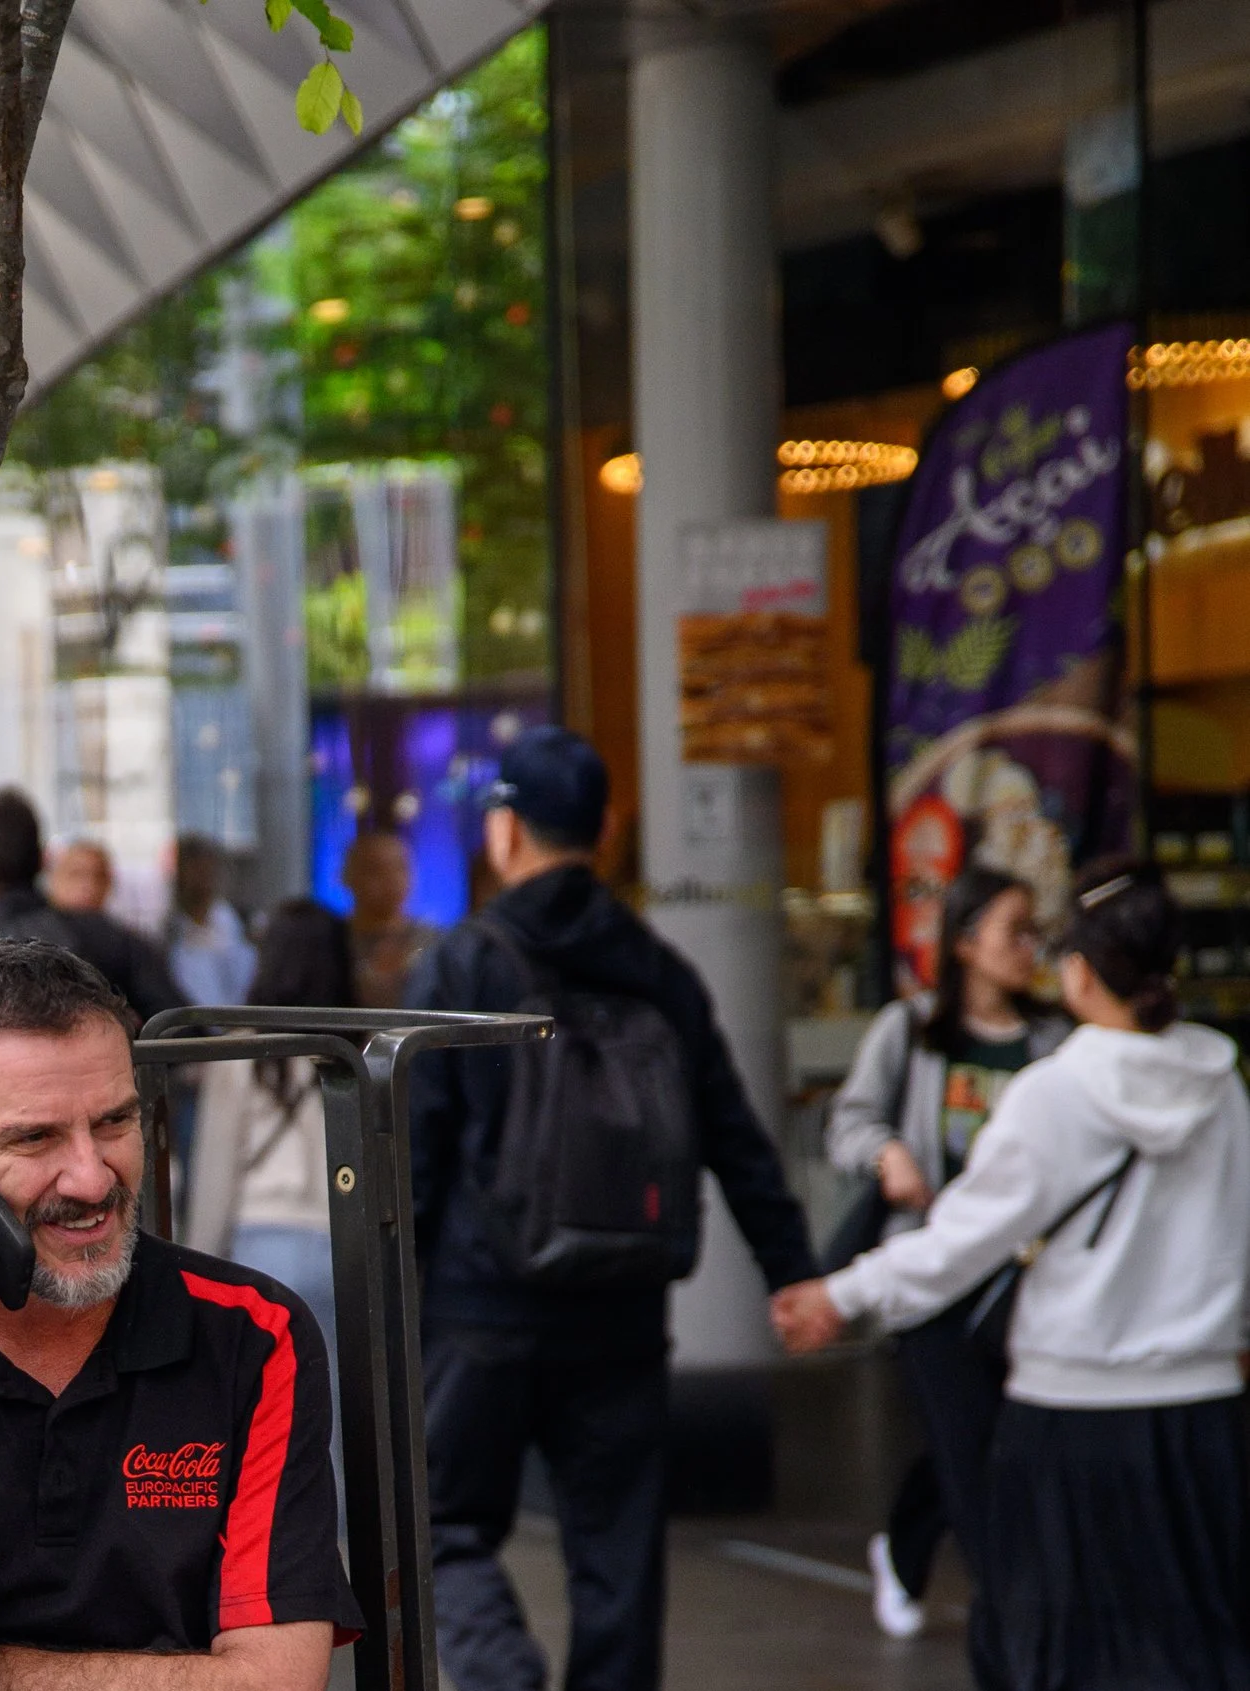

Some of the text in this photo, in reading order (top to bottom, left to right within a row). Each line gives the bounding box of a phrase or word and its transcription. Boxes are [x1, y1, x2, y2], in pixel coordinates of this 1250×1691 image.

[123, 1442, 227, 1480] Coca-Cola
[126, 1481, 219, 1494] EUROPACIFIC
[127, 1494, 219, 1508] PARTNERS
